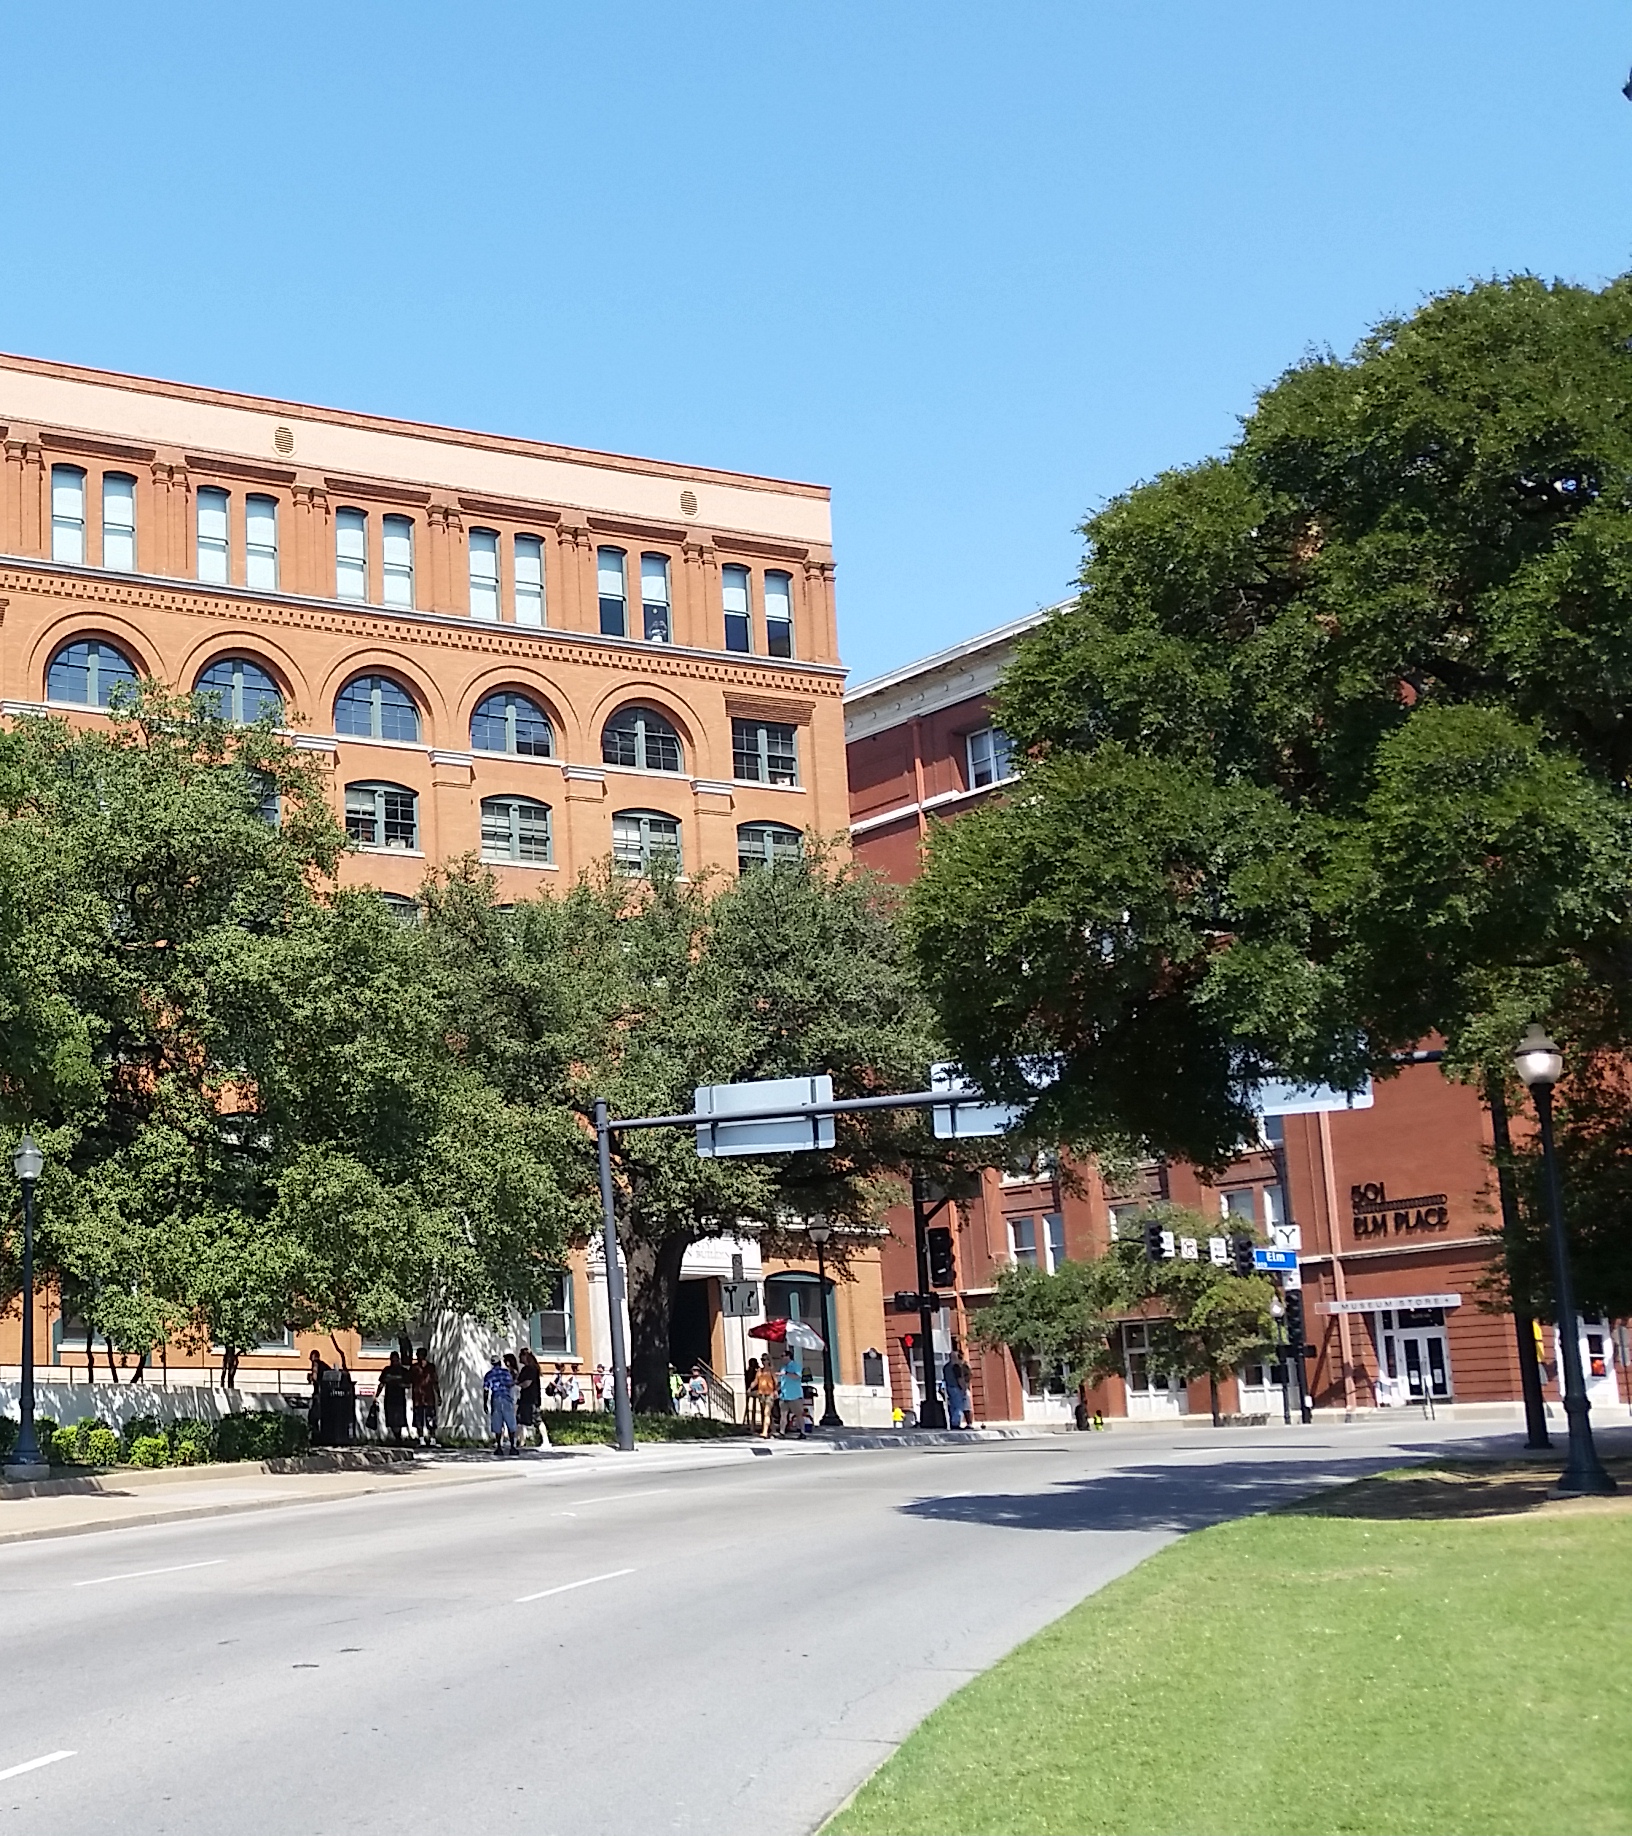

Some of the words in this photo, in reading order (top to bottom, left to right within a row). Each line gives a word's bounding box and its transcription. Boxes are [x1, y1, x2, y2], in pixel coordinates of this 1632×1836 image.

[1351, 1181, 1386, 1205] 501
[1353, 1213, 1388, 1238] ELM
[1394, 1206, 1450, 1235] PLACE
[1266, 1250, 1286, 1263] Elm
[1341, 1300, 1393, 1310] MUSEUM
[1399, 1298, 1440, 1307] STORE
